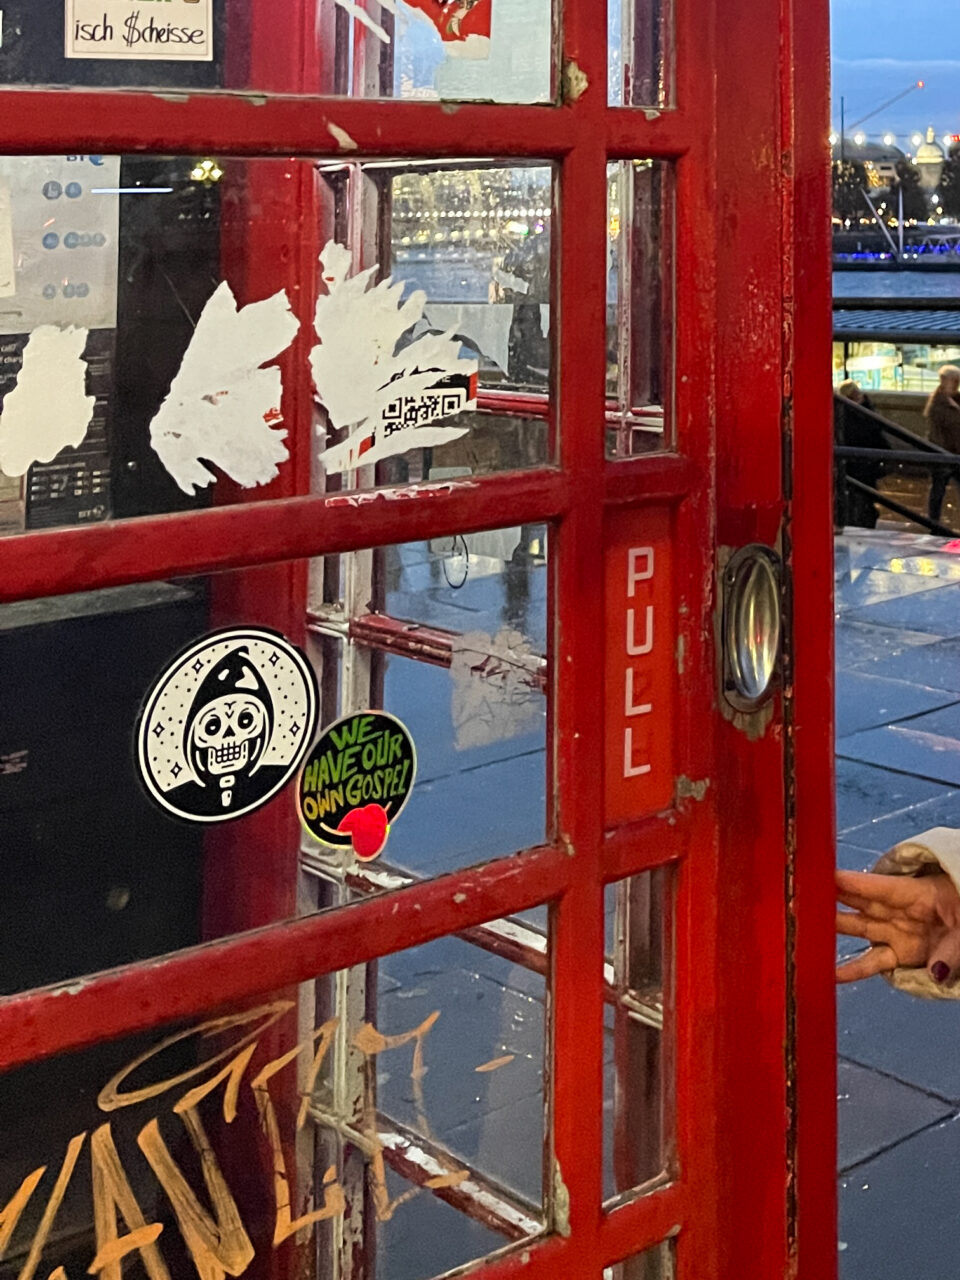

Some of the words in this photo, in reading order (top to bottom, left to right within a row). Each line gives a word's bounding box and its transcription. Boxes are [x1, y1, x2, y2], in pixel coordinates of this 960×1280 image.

[75, 13, 113, 41] isch
[623, 547, 654, 778] PULL
[304, 745, 362, 793] HAVE
[362, 730, 403, 770] OUR
[329, 716, 383, 750] WE
[303, 784, 345, 820] OWN
[346, 759, 410, 806] GOSPEL
